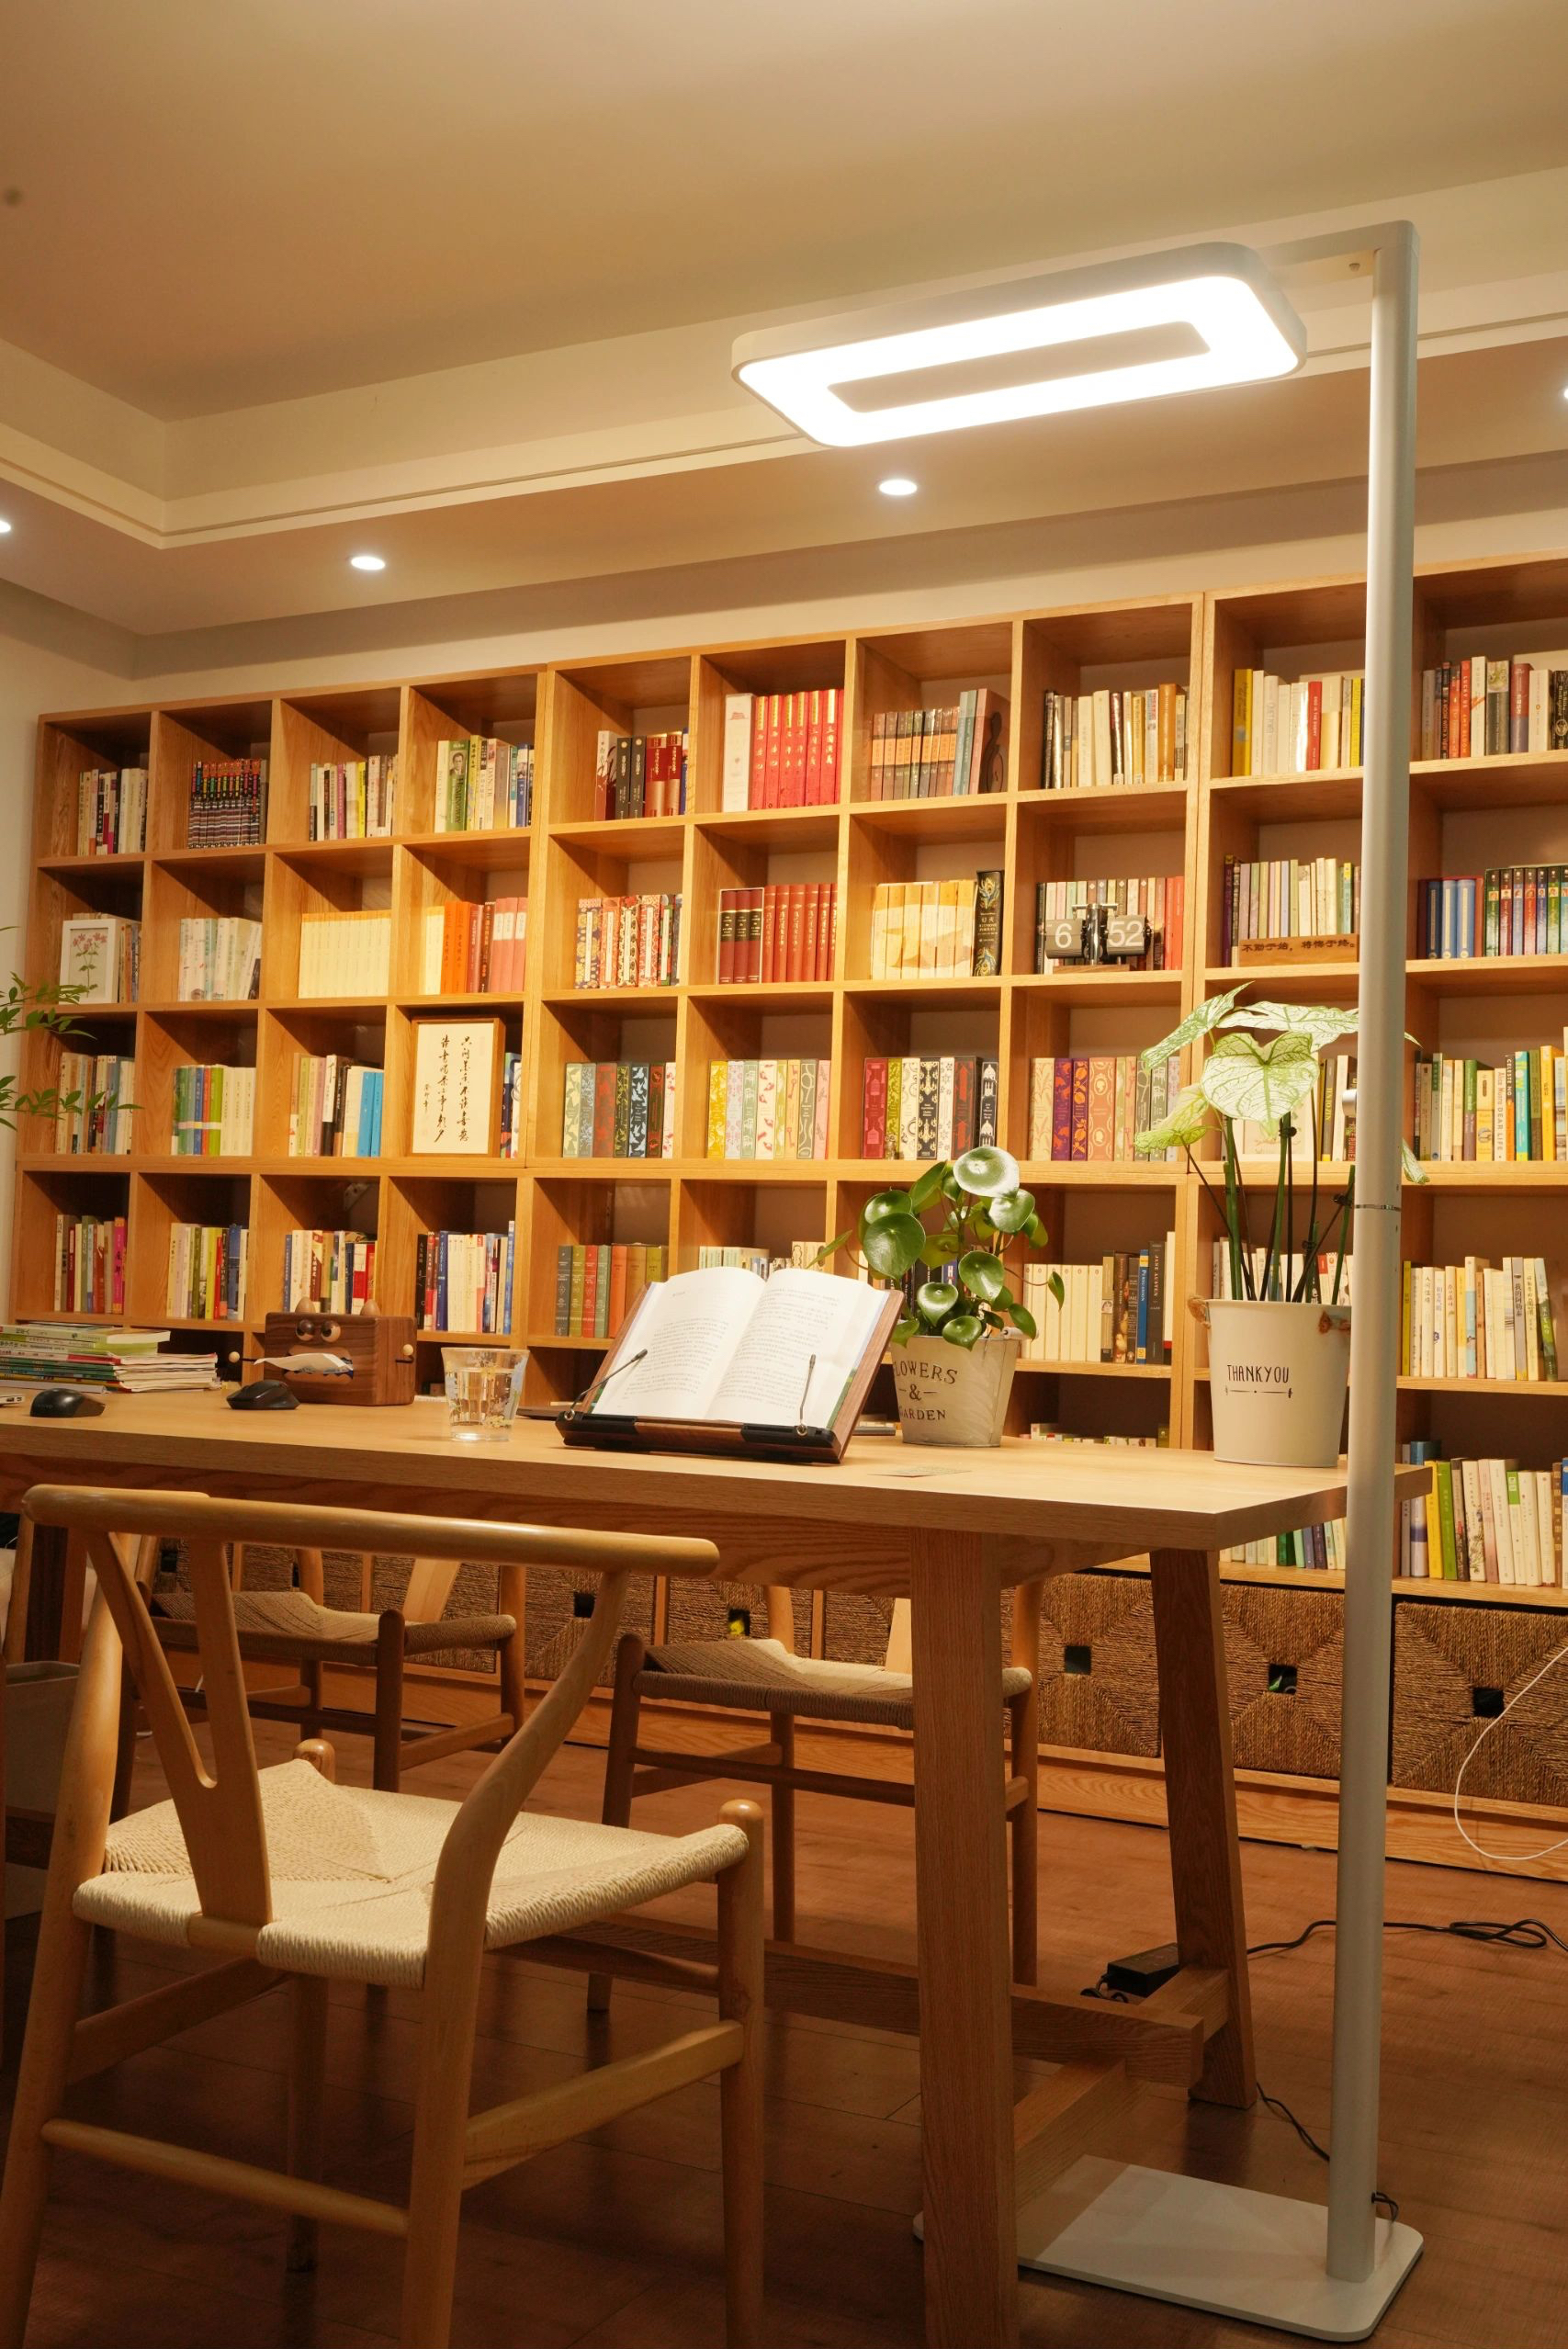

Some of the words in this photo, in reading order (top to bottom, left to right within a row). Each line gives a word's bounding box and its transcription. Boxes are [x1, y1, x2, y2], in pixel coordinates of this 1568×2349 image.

[455, 778, 465, 823] HEMINGWAY
[1055, 922, 1072, 949] 6
[1109, 920, 1143, 947] 52
[1506, 1086, 1513, 1096] NG
[894, 1360, 957, 1384] LOWERS
[909, 1383, 922, 1401] &
